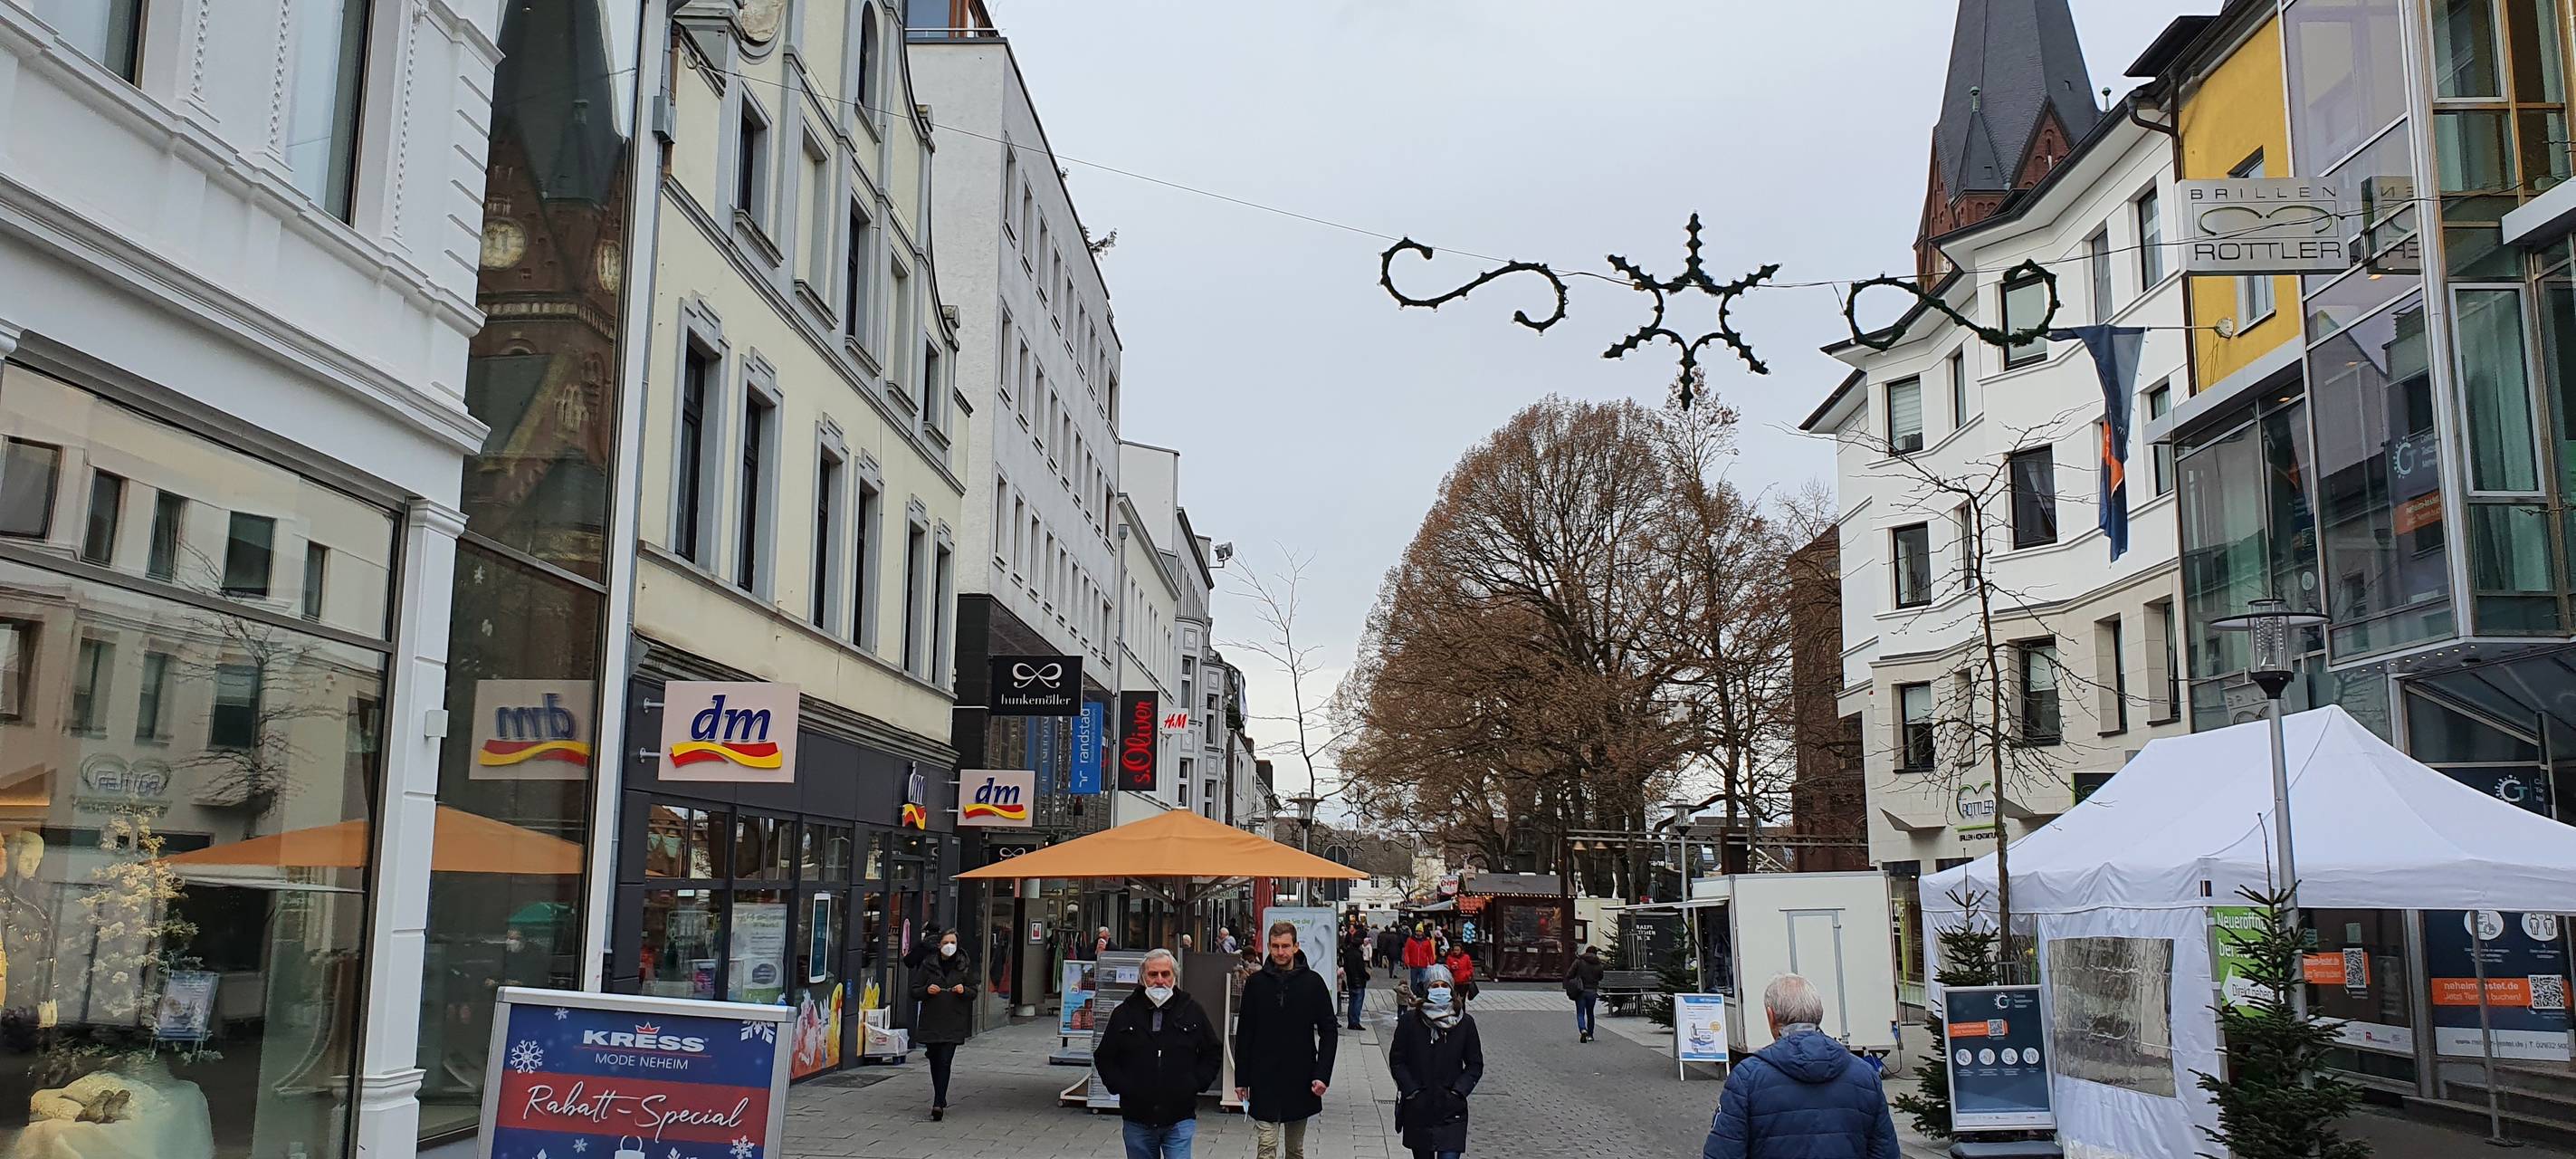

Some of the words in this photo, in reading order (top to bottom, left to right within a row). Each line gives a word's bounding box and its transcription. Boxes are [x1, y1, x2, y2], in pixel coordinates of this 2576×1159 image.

[2190, 187, 2336, 199] BRILLEN
[2194, 242, 2342, 261] ROTTLER
[1001, 694, 1072, 705] hunkemöller
[691, 694, 771, 741] dm
[1078, 708, 1091, 763] randstad
[1121, 700, 1152, 783] s.Oliver
[975, 777, 1020, 804] dm
[582, 1029, 705, 1052] KRESS
[595, 1053, 634, 1067] MODE
[640, 1056, 689, 1069] NEHEIM
